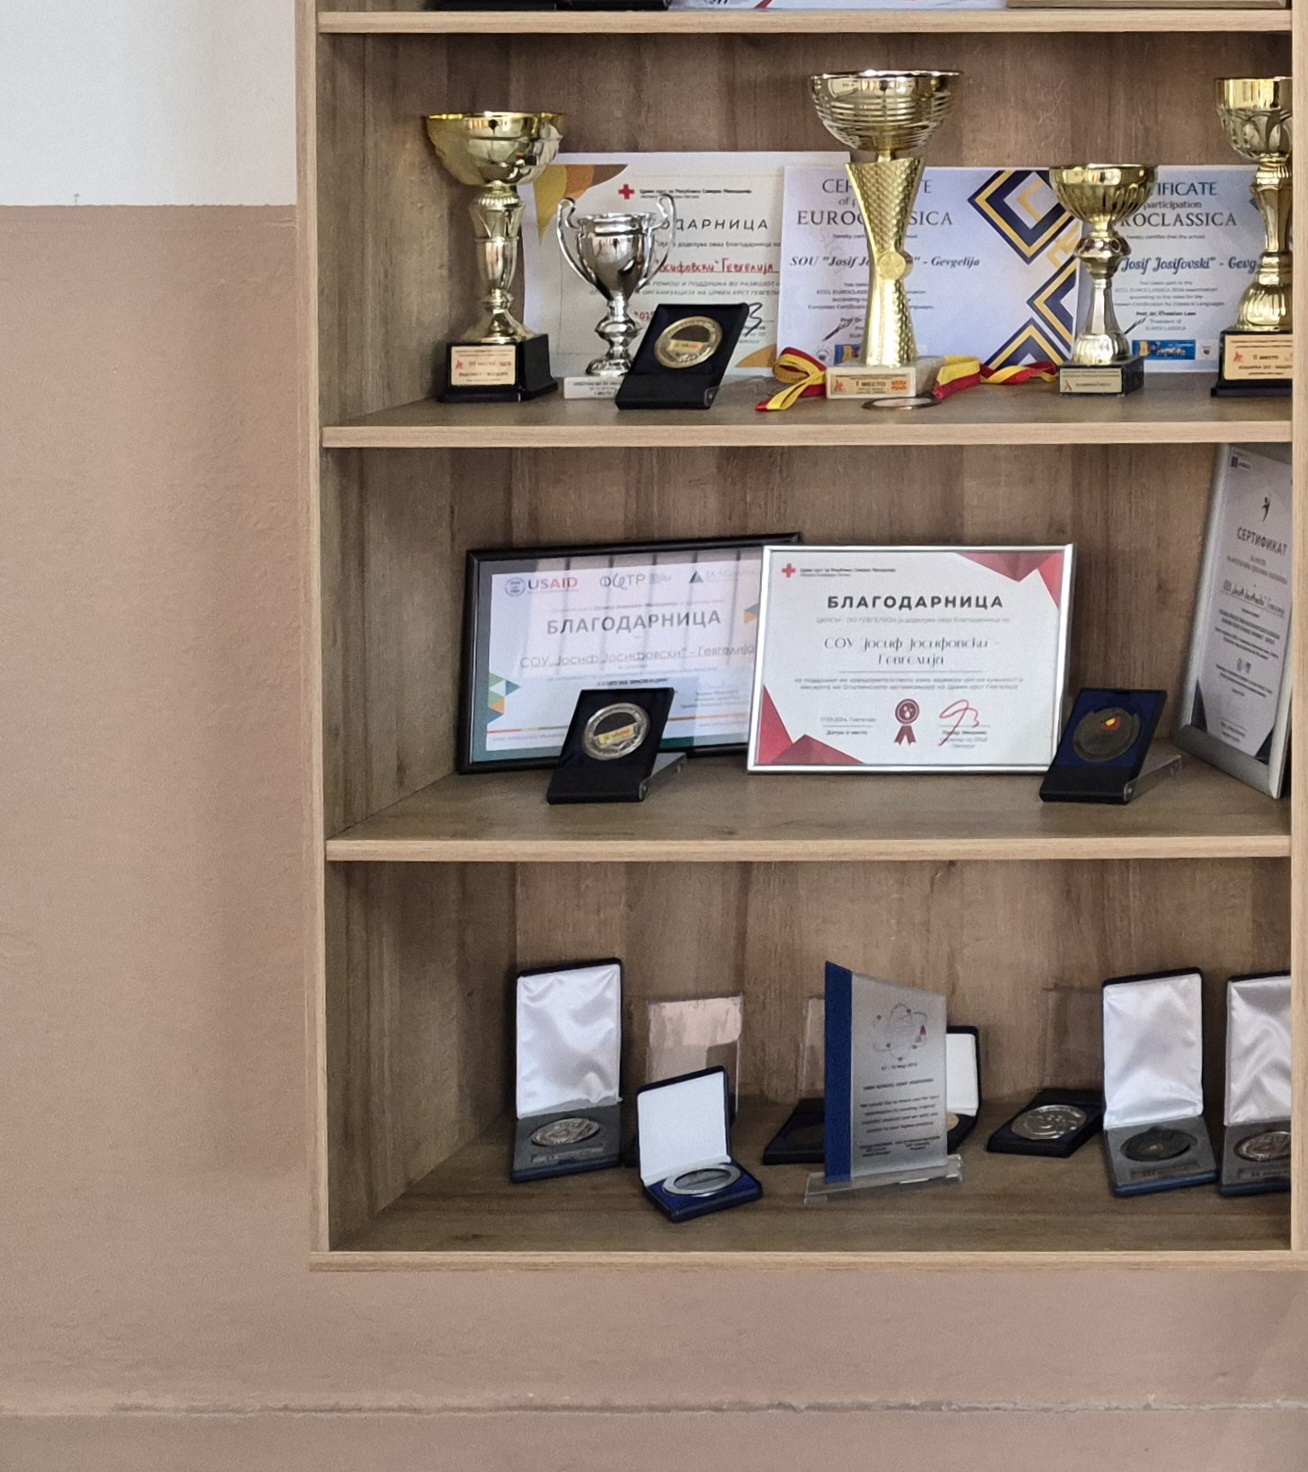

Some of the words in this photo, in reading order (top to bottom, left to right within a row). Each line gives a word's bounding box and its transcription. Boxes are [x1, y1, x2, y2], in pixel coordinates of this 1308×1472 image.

[1152, 182, 1217, 196] IFICATE
[839, 197, 850, 206] of
[1144, 200, 1202, 212] participation
[661, 218, 768, 232] ОДАРНИЦА
[1118, 212, 1237, 227] ROCLASSICA
[790, 256, 817, 266] SOU
[931, 256, 980, 267] Gevgelija
[527, 577, 578, 591] USAID
[828, 595, 1004, 610] БЛАГОДАРНИЦА
[547, 609, 721, 635] БЛАГОДАРНИЦА
